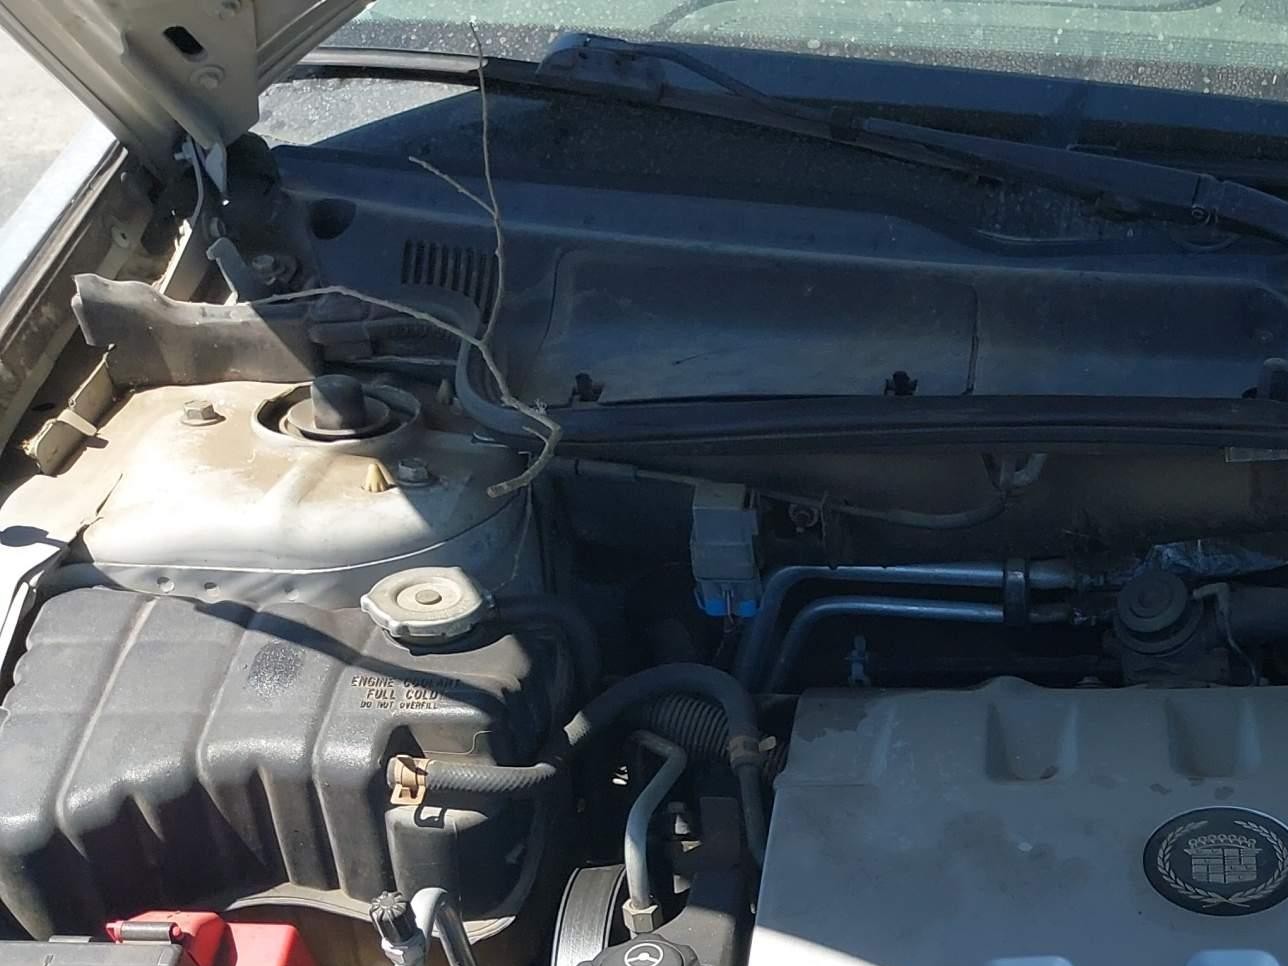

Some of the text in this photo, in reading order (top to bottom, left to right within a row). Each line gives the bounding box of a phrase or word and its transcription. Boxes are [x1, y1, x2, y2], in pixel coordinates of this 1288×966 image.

[351, 676, 393, 687] ENGINE
[367, 689, 438, 700] FULL COLD
[377, 701, 394, 709] NOT
[400, 701, 438, 709] OVERFILL
